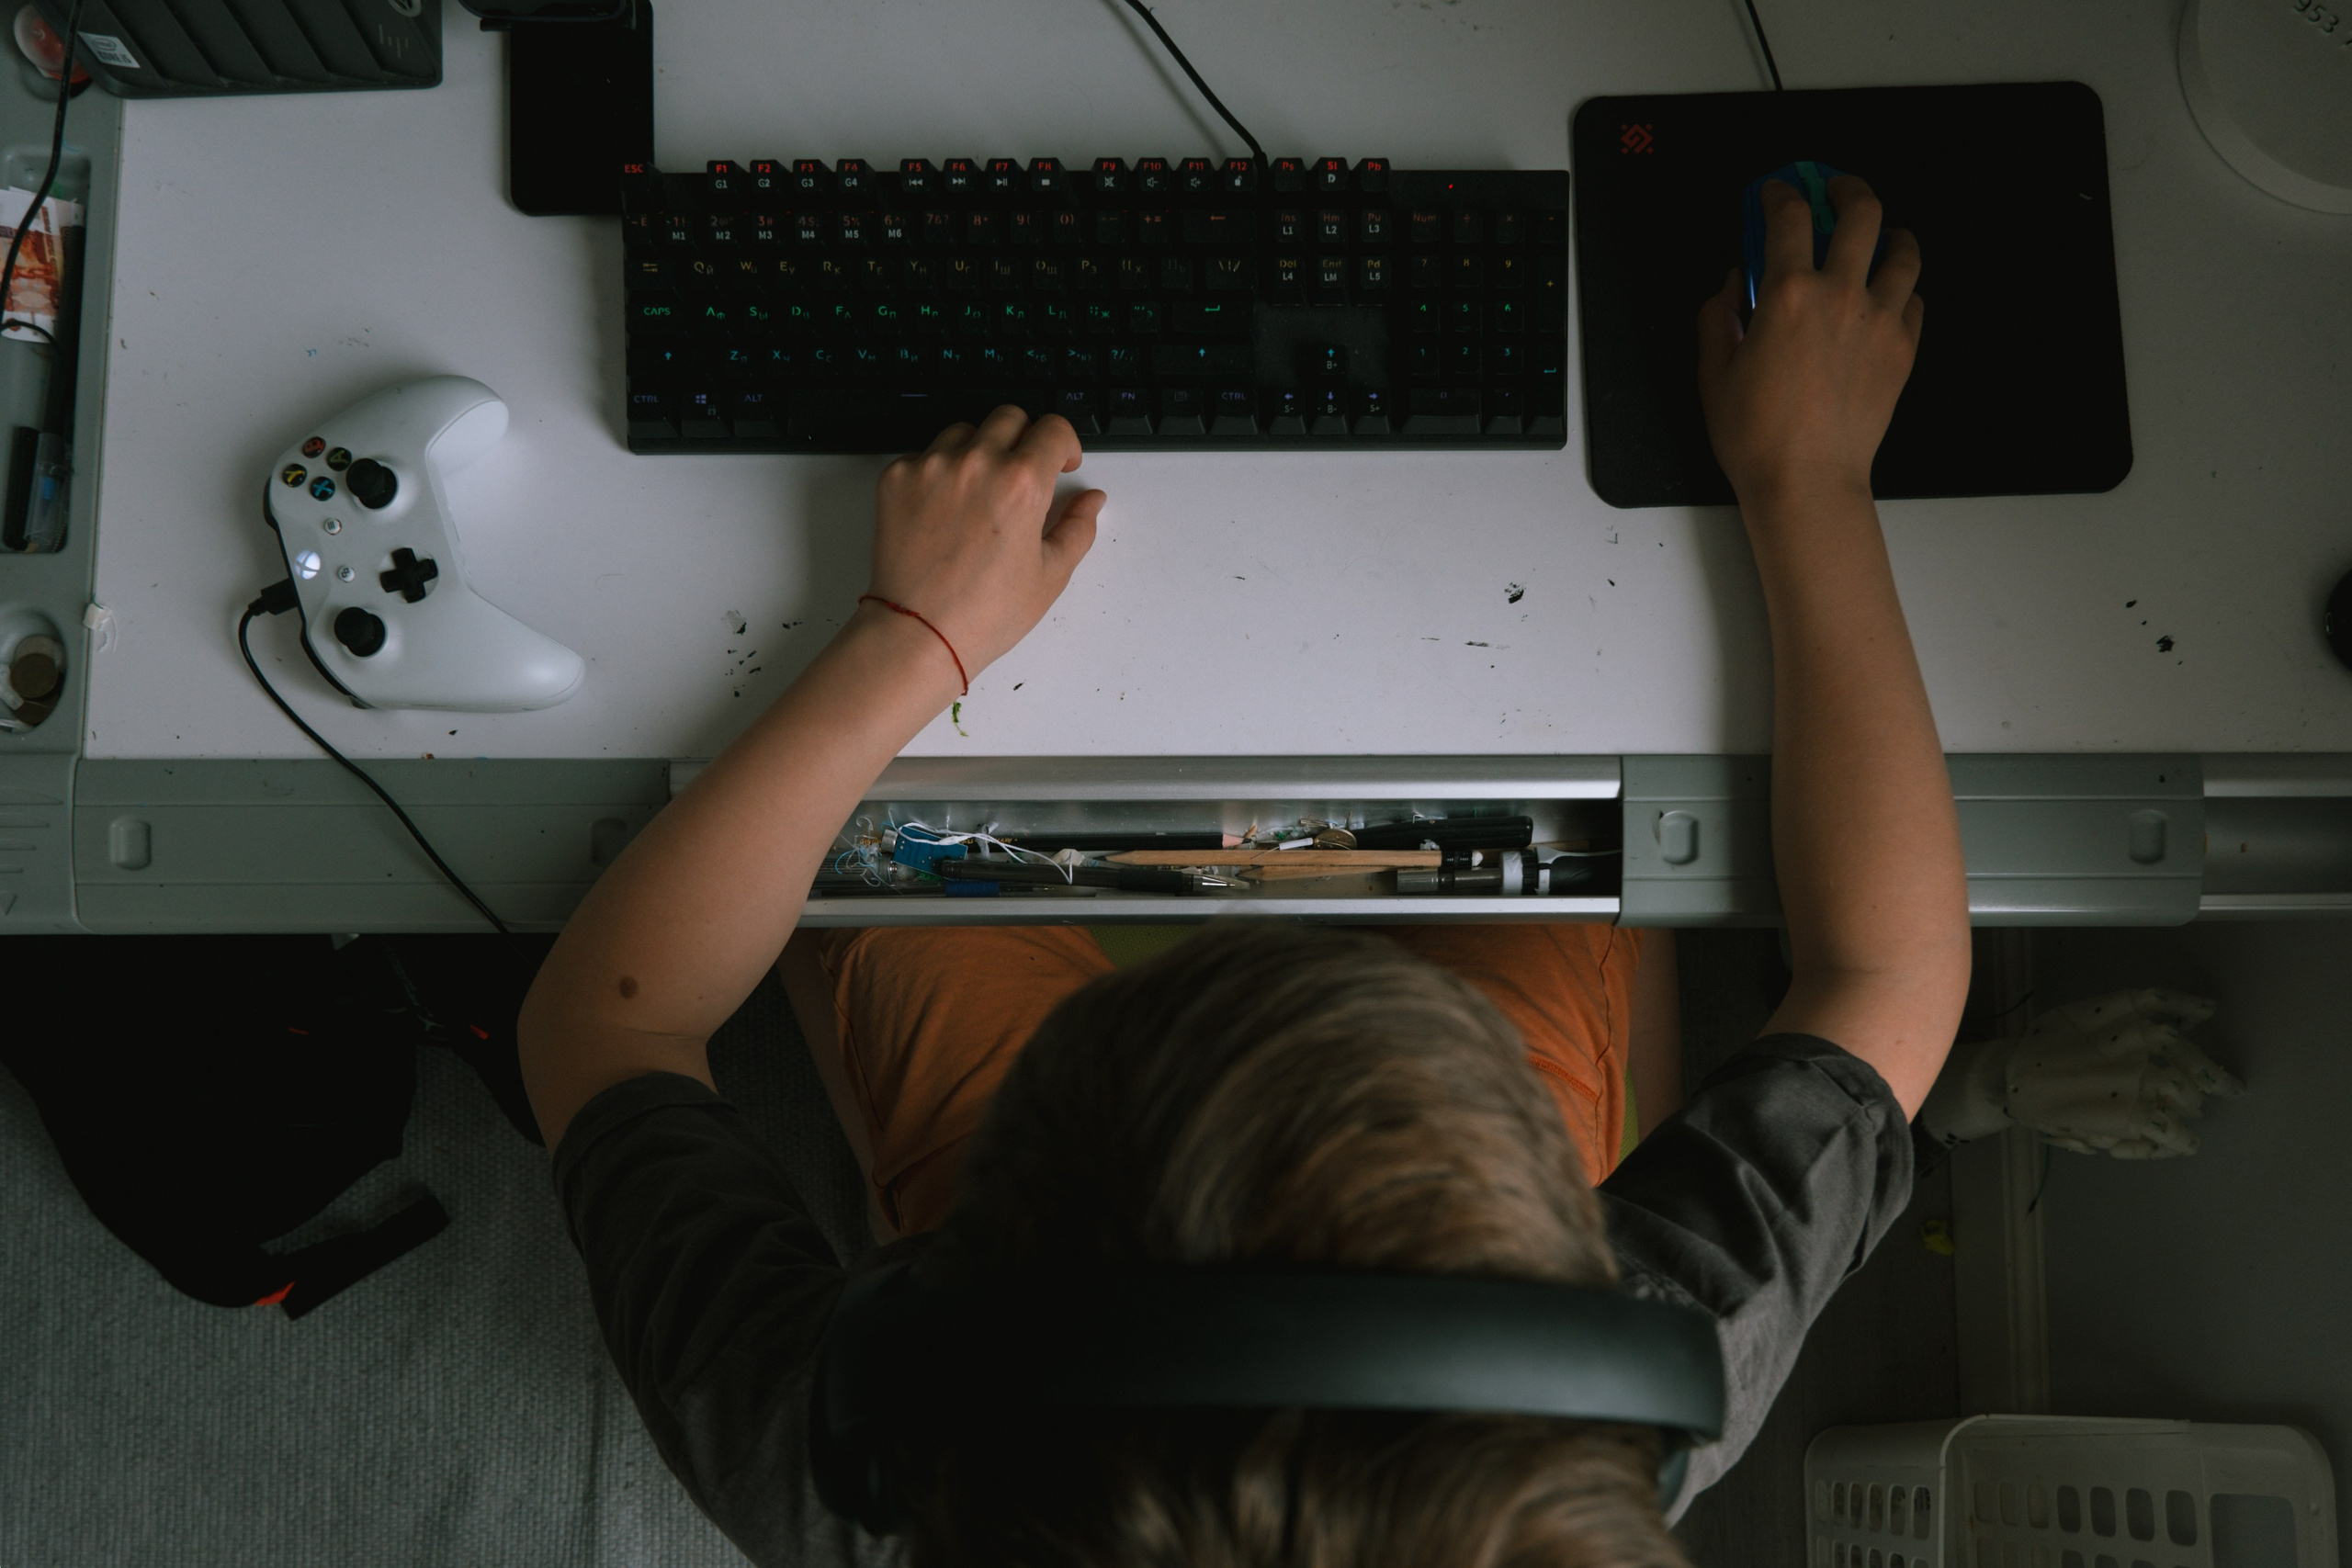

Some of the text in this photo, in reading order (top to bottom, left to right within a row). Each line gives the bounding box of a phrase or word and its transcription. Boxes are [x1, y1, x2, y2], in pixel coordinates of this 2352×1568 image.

[625, 164, 643, 173] ESC
[716, 164, 728, 174] F1
[758, 164, 771, 173] F2
[801, 164, 814, 173] F3
[844, 164, 858, 172] F4
[909, 164, 922, 172] F5
[952, 163, 966, 172] F6
[996, 163, 1009, 172] F7
[1038, 162, 1052, 171] F8
[1102, 162, 1116, 172] F9
[1143, 162, 1161, 171] F10
[1189, 162, 1204, 171] F11
[1230, 162, 1248, 171] F12
[1282, 162, 1295, 172] Ps
[1368, 162, 1382, 171] Pb
[758, 178, 771, 188] G2
[801, 178, 814, 187] G3
[844, 177, 858, 187] G4
[1328, 174, 1336, 184] D
[715, 180, 729, 189] G1
[1281, 213, 1296, 222] Ins
[1323, 213, 1340, 222] Hm
[1412, 213, 1436, 222] Num
[1283, 226, 1294, 235] L1
[1326, 225, 1338, 234] L2
[1368, 224, 1380, 233] L3
[672, 231, 685, 240] M1
[716, 231, 730, 240] M2
[758, 231, 773, 240] M3
[801, 230, 815, 239] M4
[844, 230, 859, 239] M5
[888, 229, 902, 238] M6
[1279, 259, 1297, 268] Del
[1322, 259, 1341, 268] End
[1367, 260, 1380, 268] Pd
[1283, 272, 1294, 281] L4
[1324, 273, 1337, 282] LM
[643, 307, 671, 316] CAPS
[633, 395, 660, 403] CTRL
[744, 394, 763, 402] ALT
[1067, 392, 1084, 400] ALT
[1122, 392, 1136, 400] FN
[1221, 392, 1247, 400] CTRL
[304, 440, 322, 454] B
[330, 449, 348, 463] A
[286, 469, 305, 483] Y
[313, 479, 333, 497] X
